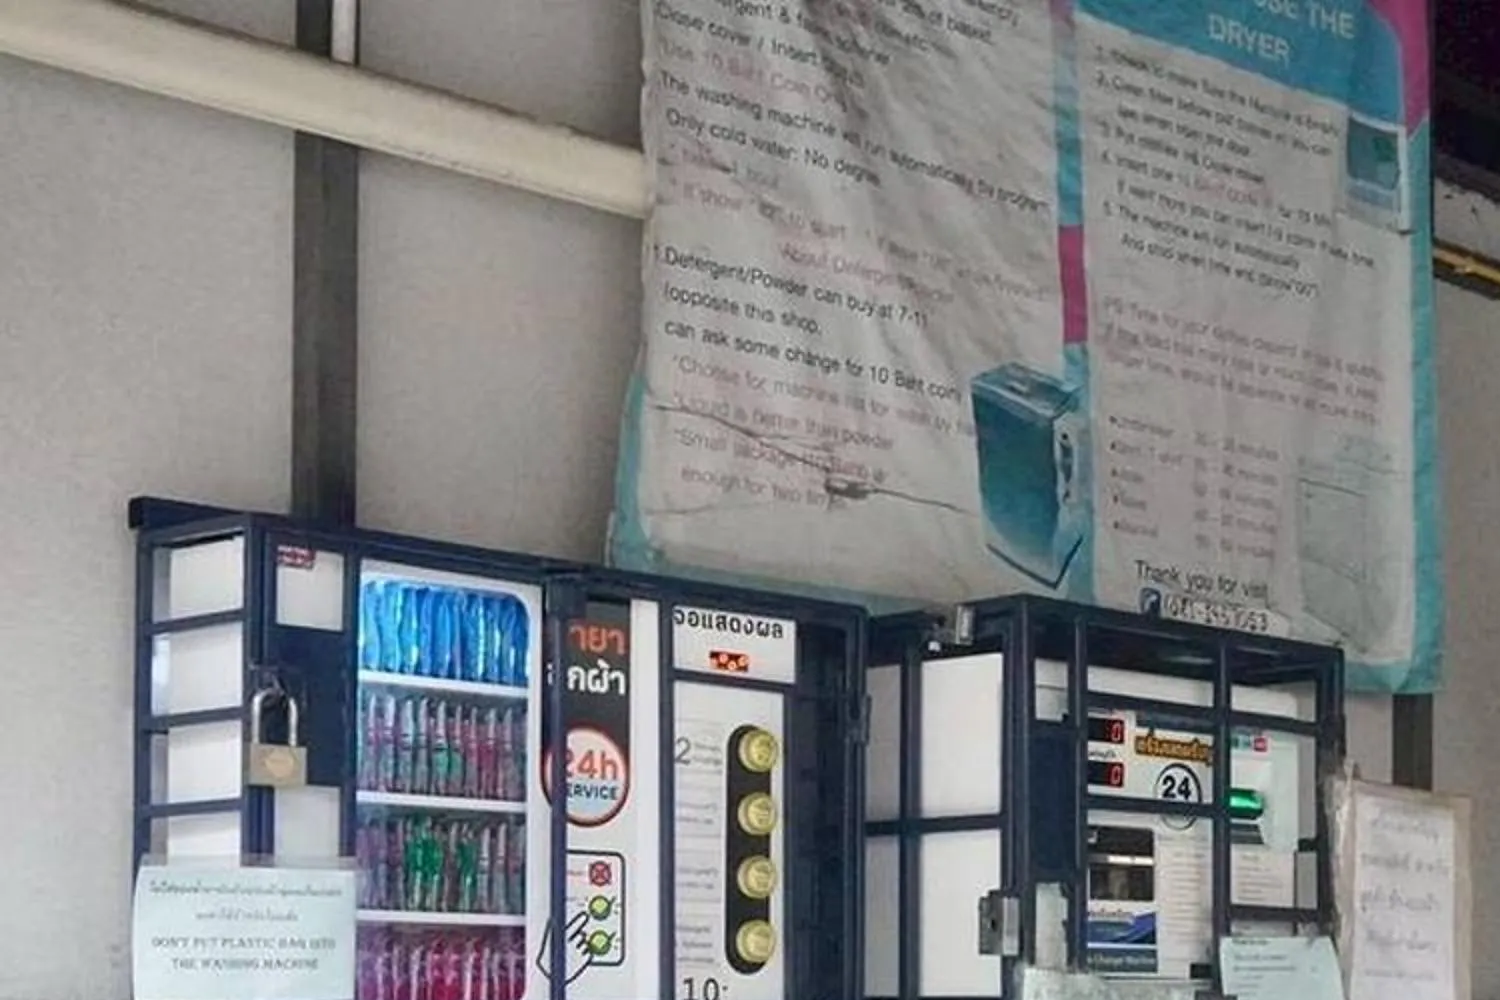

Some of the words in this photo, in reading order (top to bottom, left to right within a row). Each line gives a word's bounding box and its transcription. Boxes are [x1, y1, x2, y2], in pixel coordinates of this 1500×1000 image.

[1309, 5, 1355, 39] THE
[1208, 12, 1291, 68] DRYER
[665, 106, 706, 137] Only
[708, 123, 747, 146] cold
[803, 147, 829, 170] No
[813, 286, 843, 308] can
[744, 302, 775, 323] this
[663, 320, 696, 340] can
[701, 328, 730, 347] ask
[734, 336, 780, 359] some
[869, 365, 890, 385] 10
[1135, 559, 1180, 583] Thank
[1183, 571, 1214, 595] you
[566, 783, 619, 801] ERVICE
[1162, 775, 1192, 800] 24
[221, 936, 277, 950] PLASTIC
[171, 957, 198, 970] THE
[262, 957, 319, 971] MACHINE
